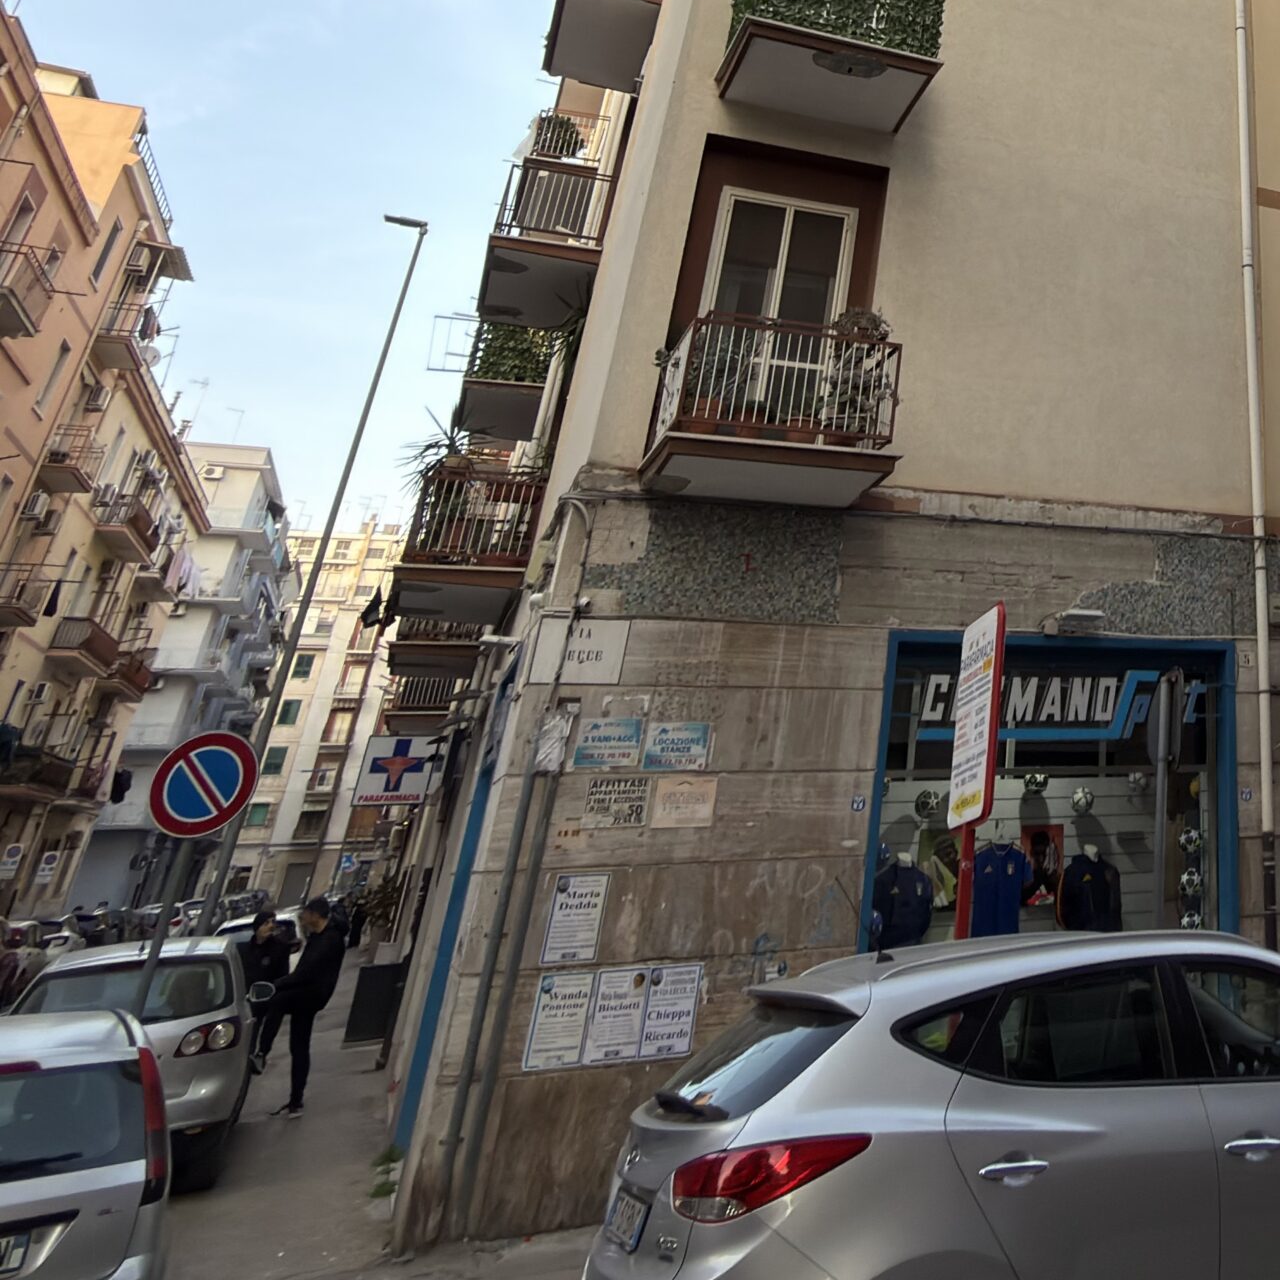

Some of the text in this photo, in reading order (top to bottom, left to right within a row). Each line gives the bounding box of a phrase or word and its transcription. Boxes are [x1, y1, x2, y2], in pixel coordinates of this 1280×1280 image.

[563, 649, 603, 662] ECCE
[920, 674, 1117, 722] CMANO
[653, 737, 701, 746] LOCAZIONE
[591, 778, 648, 789] AFFITTASI
[358, 794, 420, 803] PARAFARMACIA
[566, 890, 600, 899] Maria
[559, 901, 598, 910] Dedda
[548, 990, 588, 1000] Wanda
[598, 1002, 640, 1013] Bisciotti
[647, 1009, 691, 1021] Chieppa
[644, 1028, 689, 1042] Riccardo
